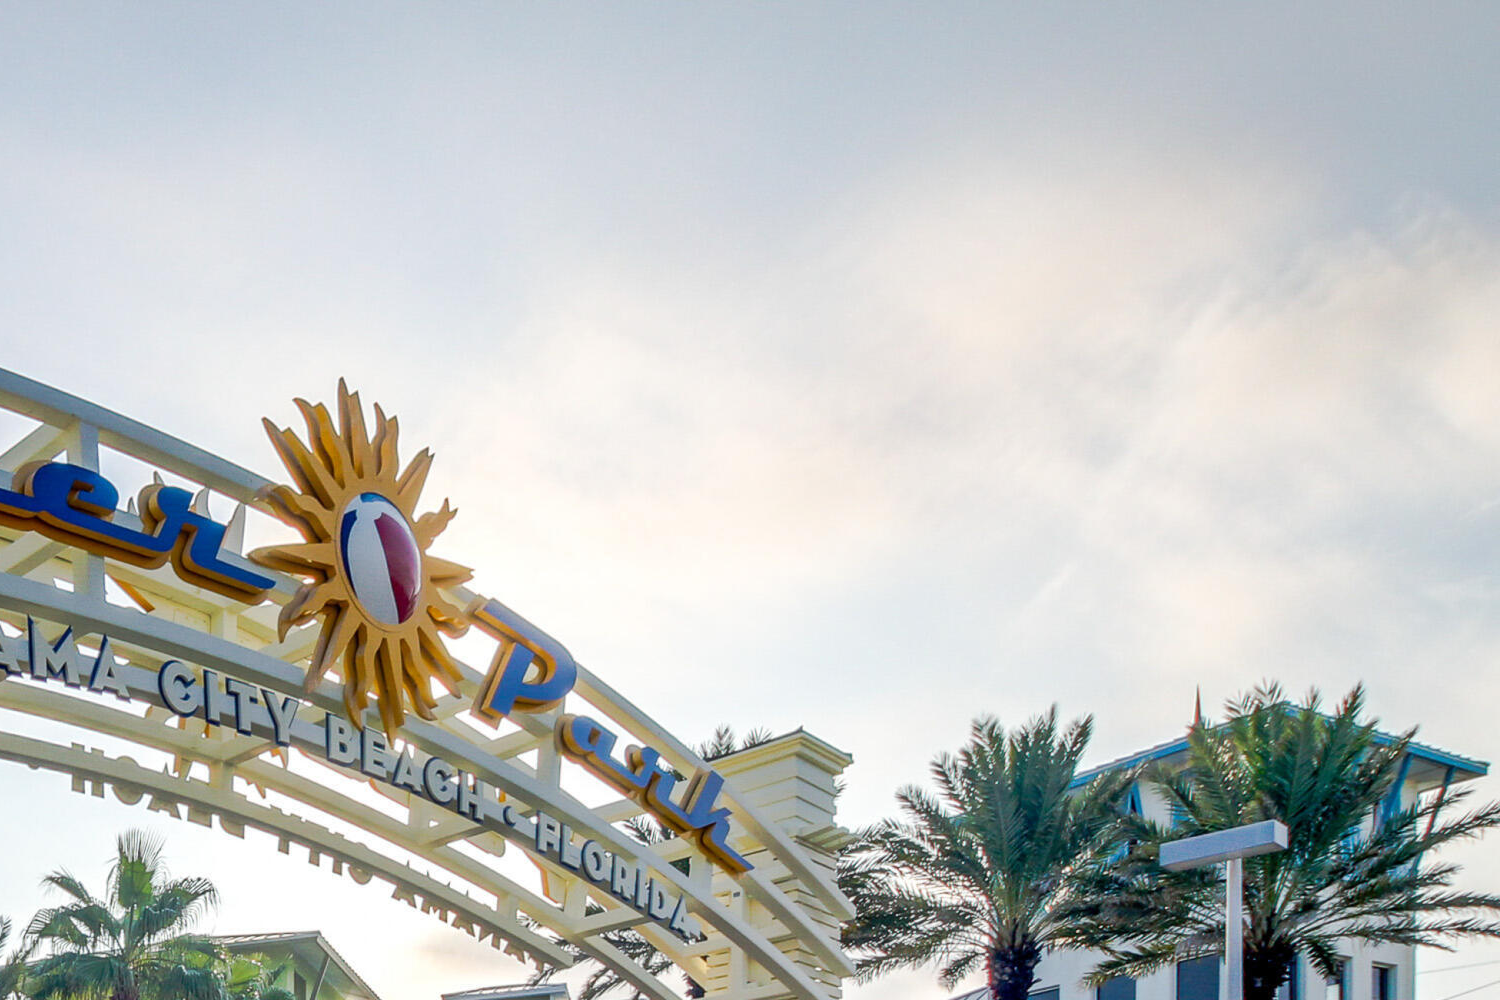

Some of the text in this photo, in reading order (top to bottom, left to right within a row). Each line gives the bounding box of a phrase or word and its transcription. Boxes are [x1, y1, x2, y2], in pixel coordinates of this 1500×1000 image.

[158, 659, 300, 747] CITY
[325, 711, 488, 825] BEACH
[536, 810, 708, 944] FLORIDA
[478, 597, 756, 876] Park
